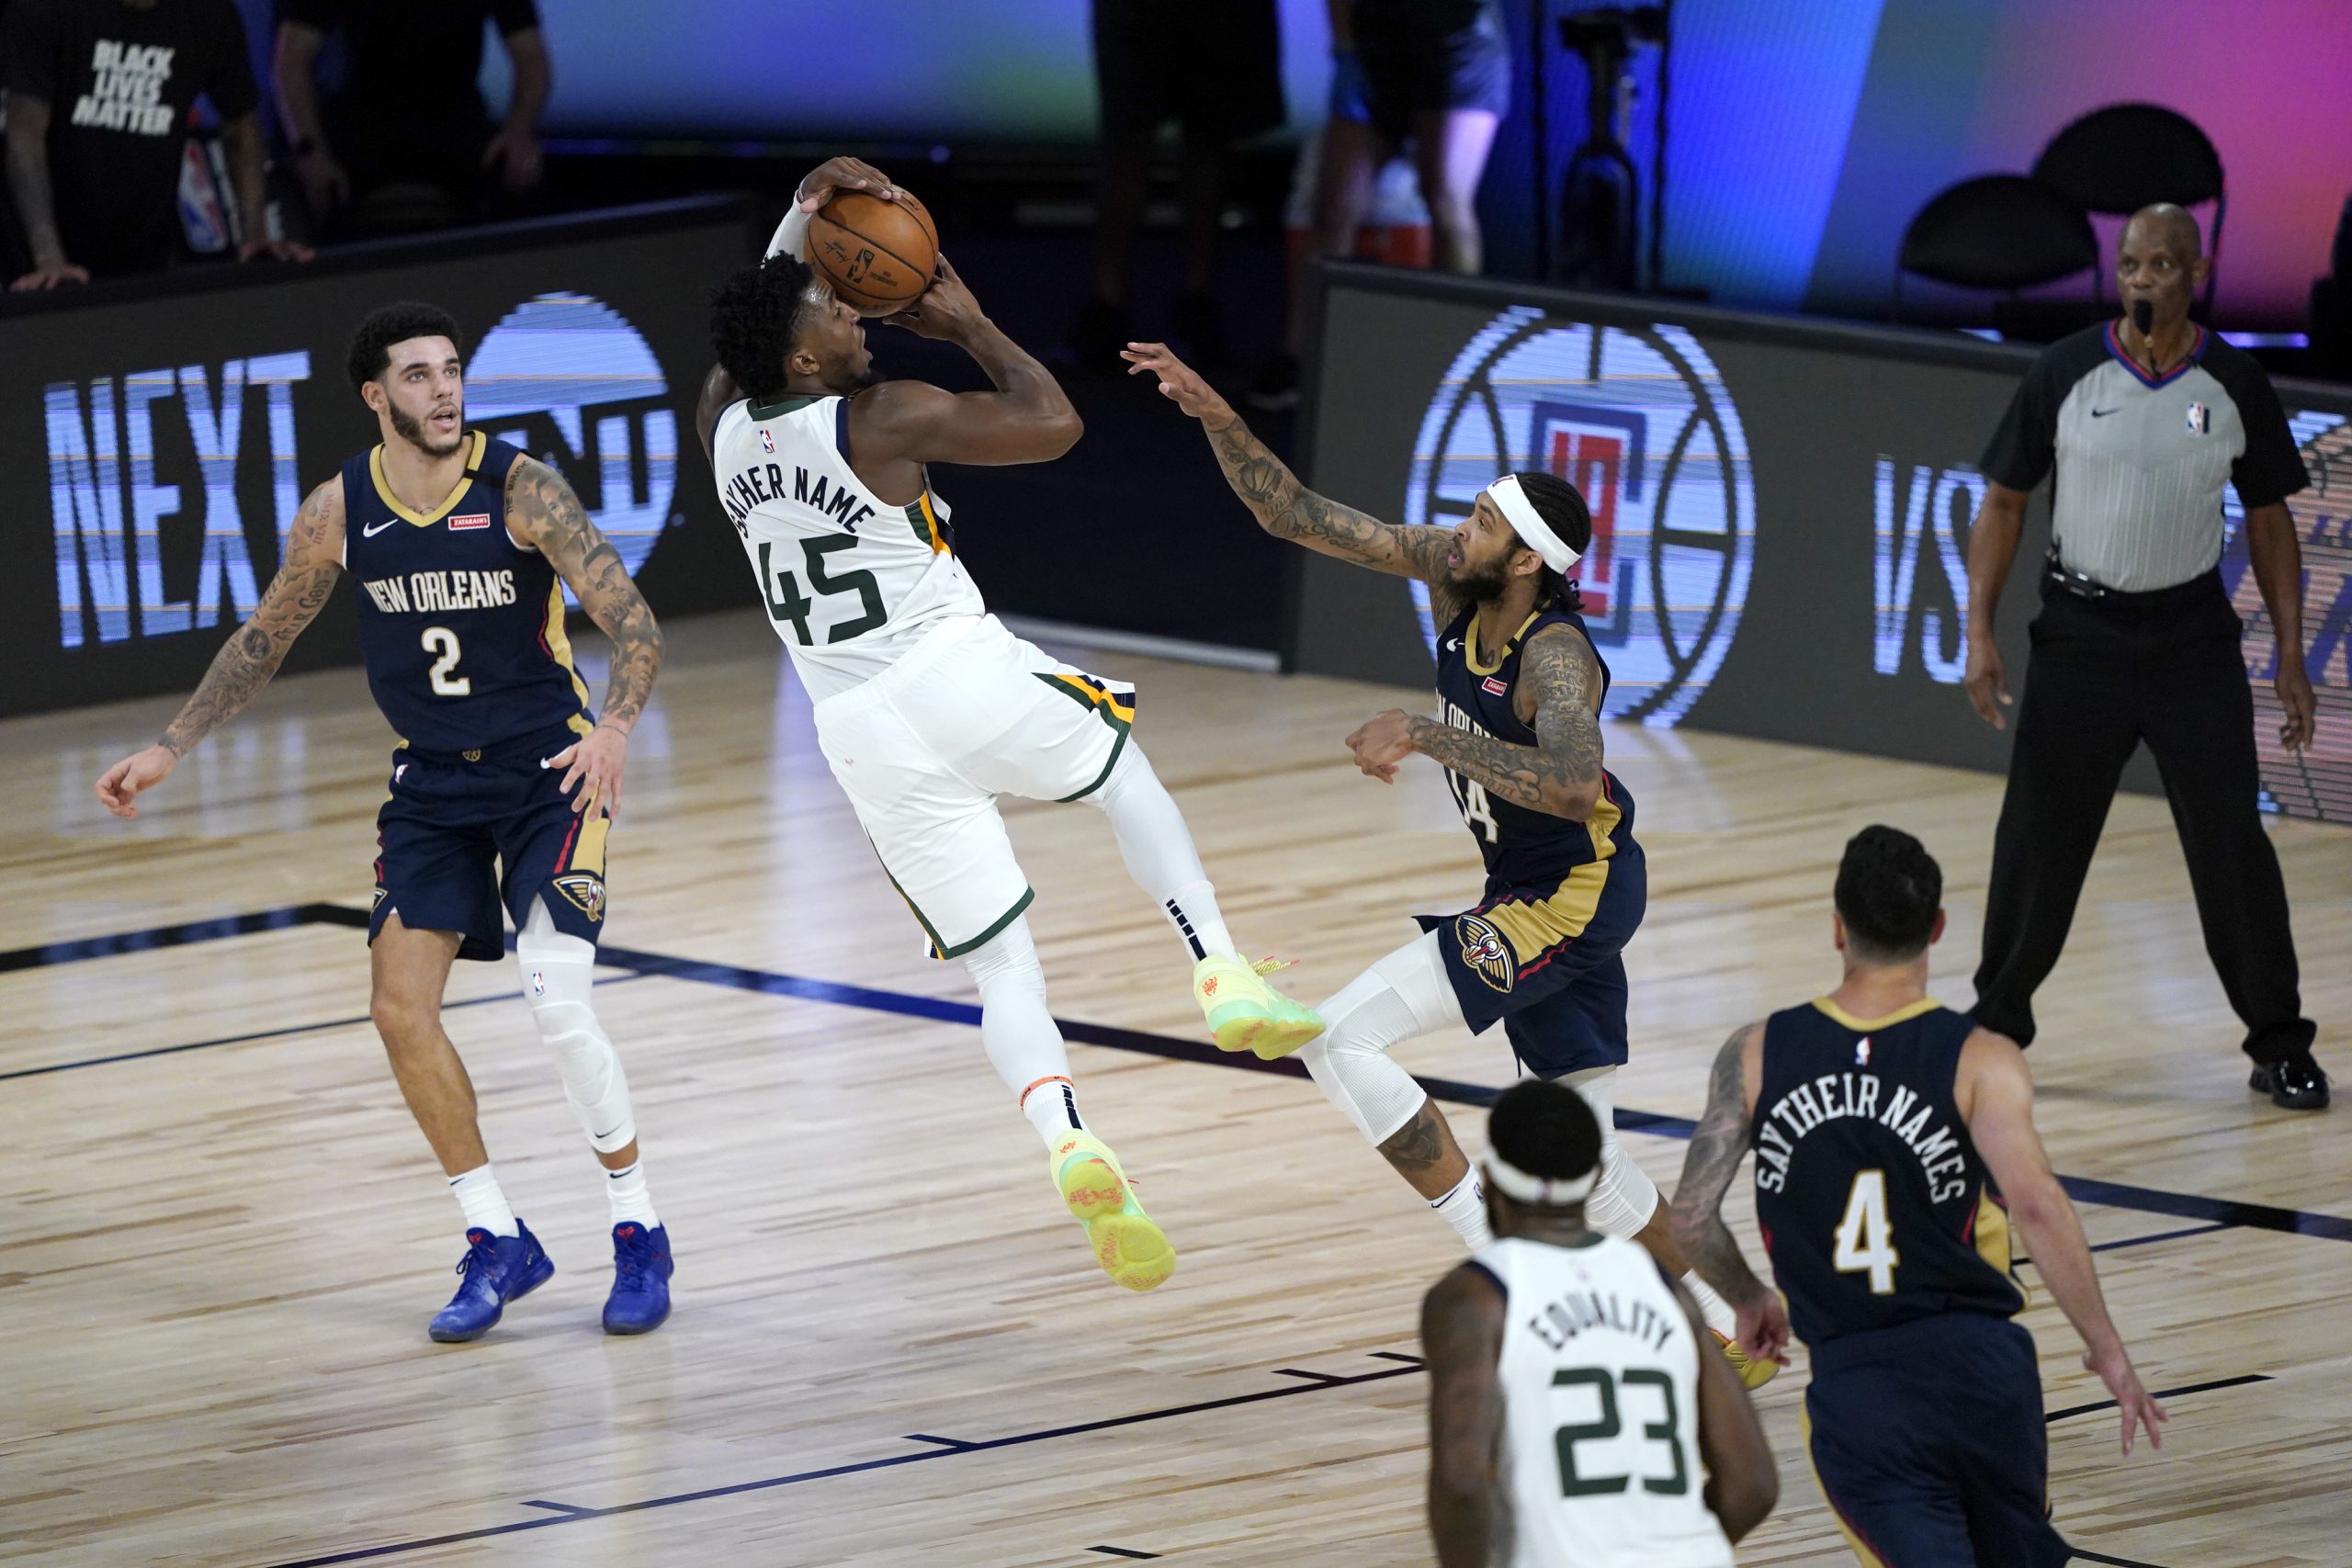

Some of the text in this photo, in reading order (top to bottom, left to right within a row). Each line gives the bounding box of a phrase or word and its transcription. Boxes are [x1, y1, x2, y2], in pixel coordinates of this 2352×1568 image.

[93, 39, 175, 81] BLACK
[94, 69, 166, 107] LIVES
[71, 94, 175, 136] MATTER
[44, 350, 311, 649] NEXT
[732, 463, 786, 510] HER
[794, 466, 876, 534] NAME
[363, 570, 517, 614] NEW ORLEANS
[758, 533, 888, 647] 45
[1874, 454, 1990, 684] VS
[421, 626, 471, 696] 2
[1757, 1072, 1967, 1204] SAY THEIR NAMES
[1833, 1168, 1900, 1295] 4
[1529, 1291, 1674, 1353] EQUALITY
[1550, 1367, 1689, 1497] 23
